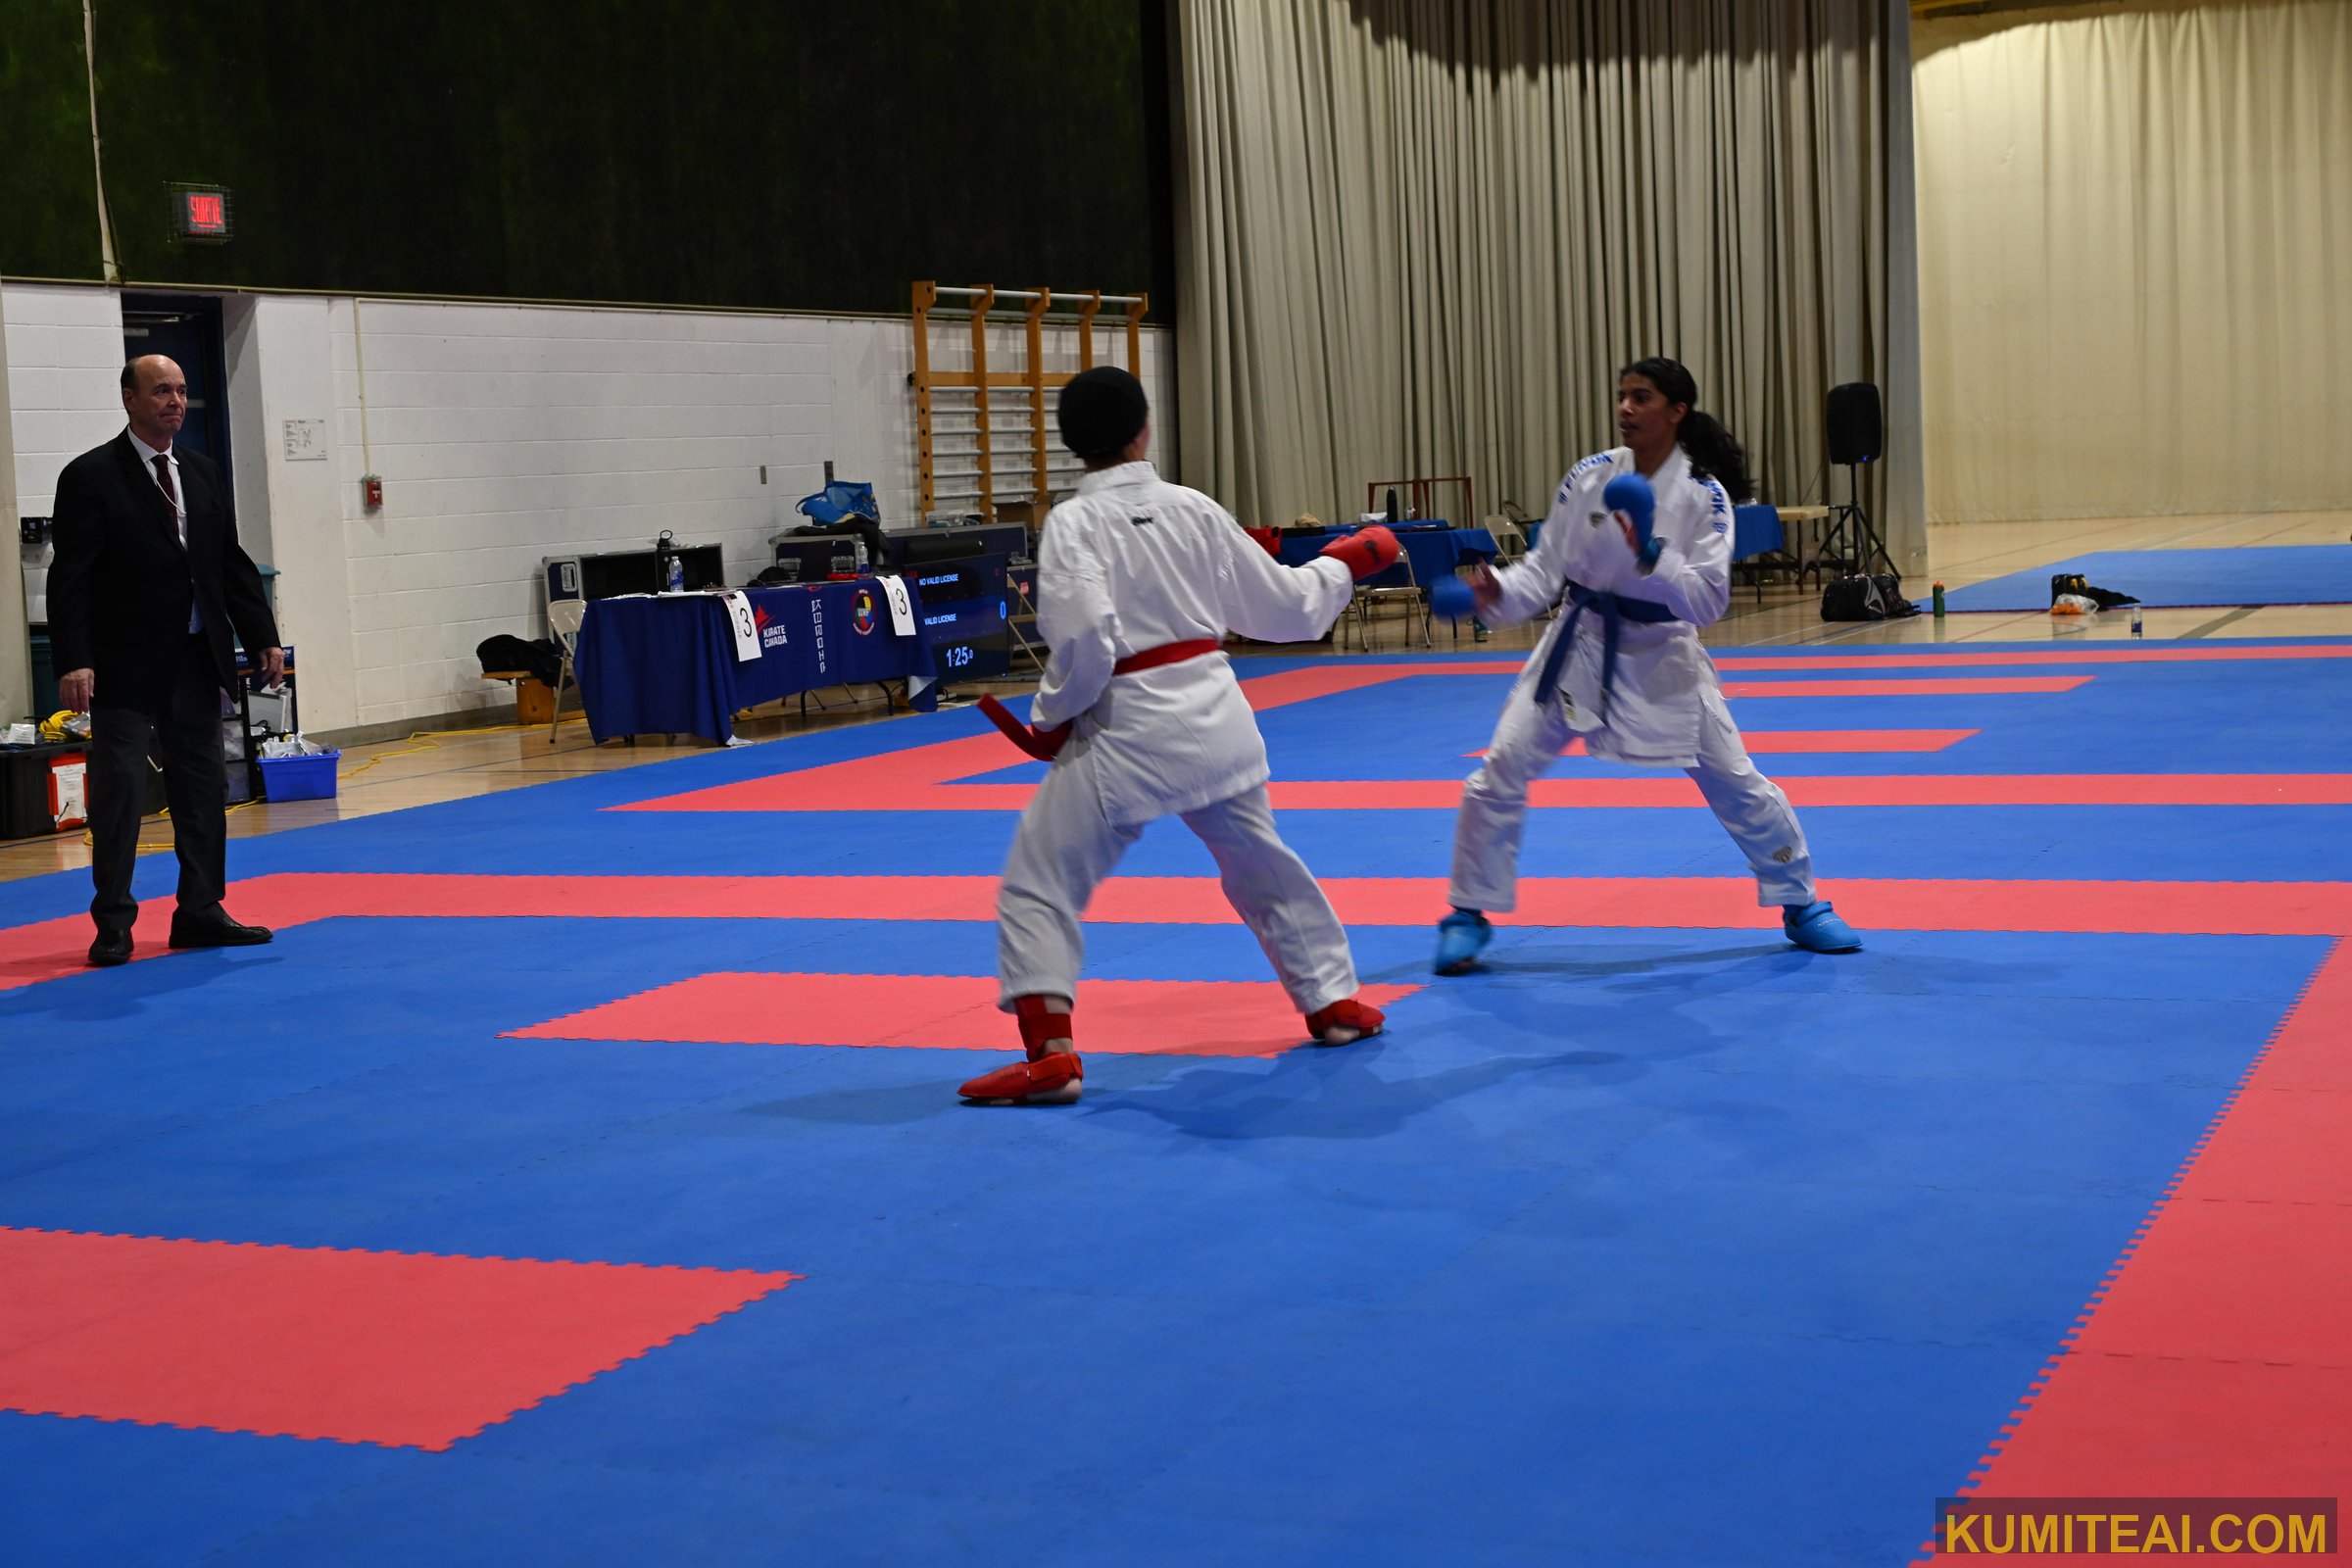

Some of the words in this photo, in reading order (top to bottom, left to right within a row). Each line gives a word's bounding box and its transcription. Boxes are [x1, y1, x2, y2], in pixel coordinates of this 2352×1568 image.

[189, 195, 222, 224] SORTIE
[927, 575, 940, 585] VALID
[940, 573, 959, 584] LICENSE
[895, 587, 907, 616] 3
[1000, 601, 1006, 620] 0
[740, 607, 753, 638] 3
[923, 615, 938, 625] VALID
[938, 613, 957, 623] LICENSE
